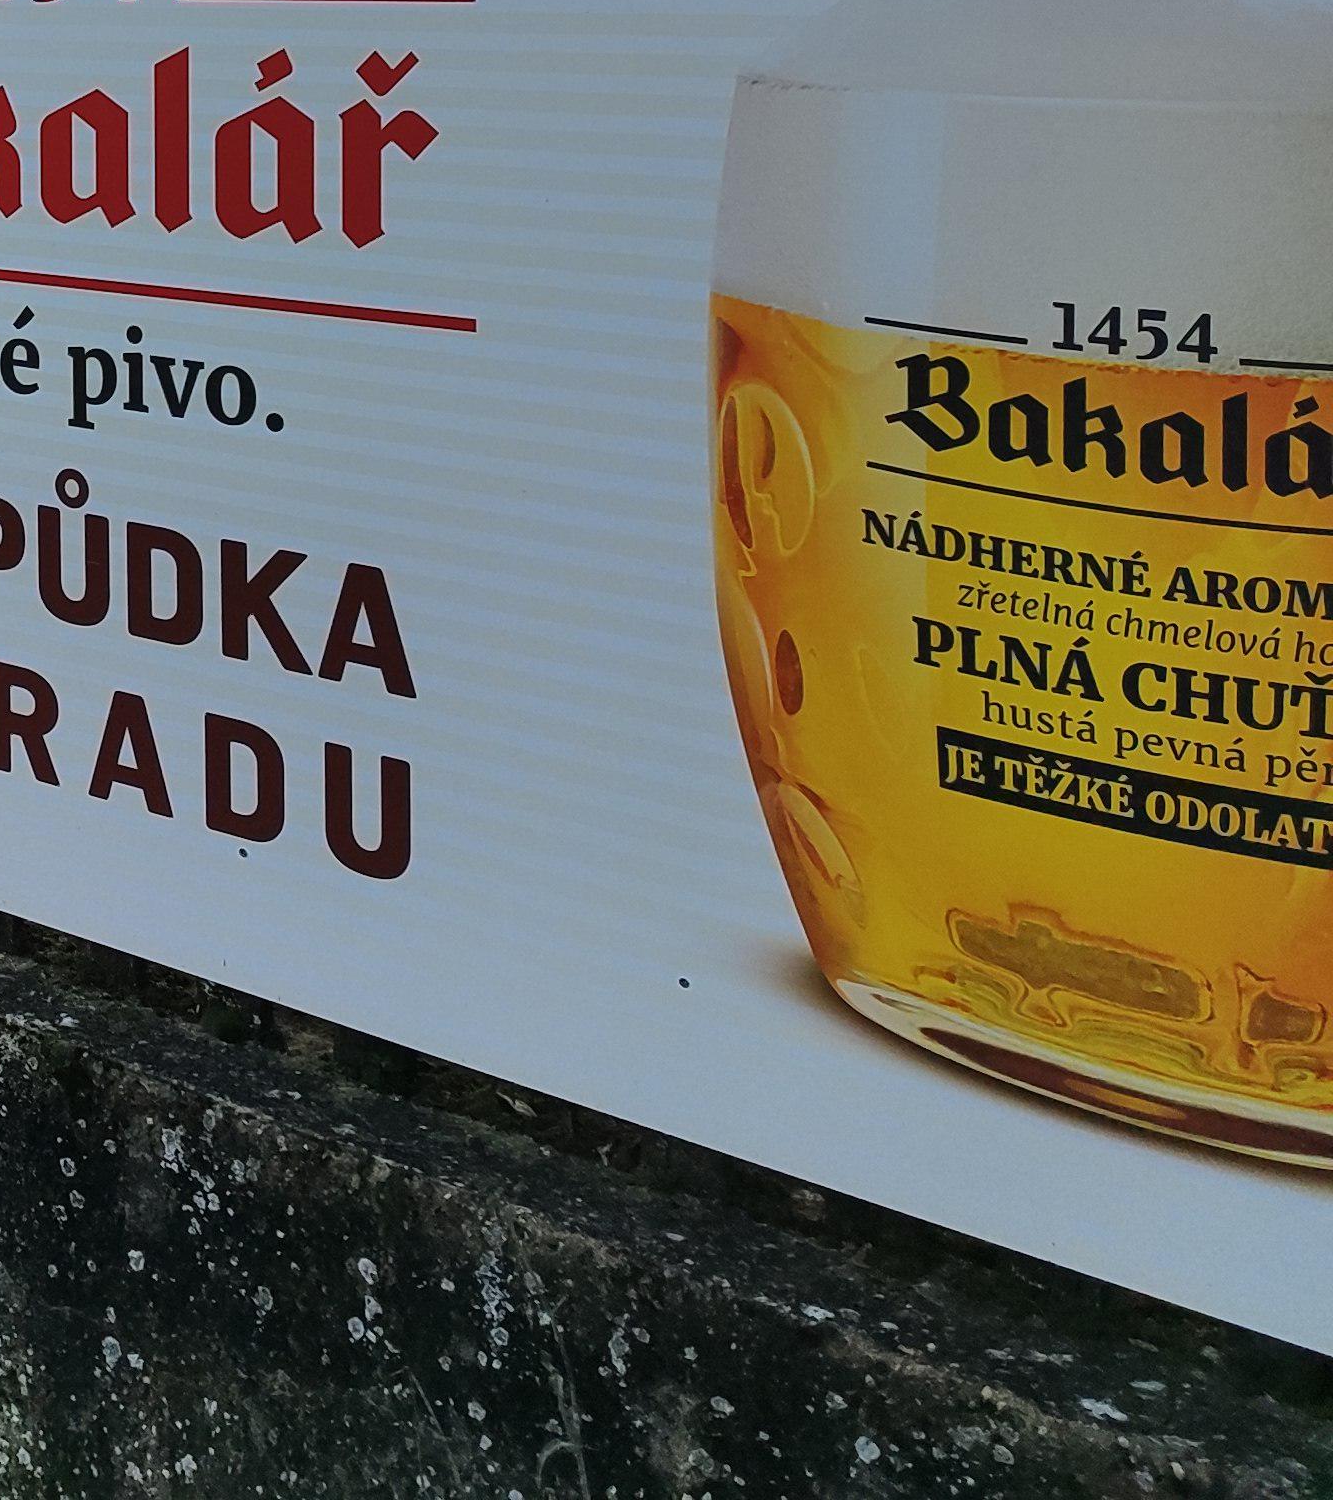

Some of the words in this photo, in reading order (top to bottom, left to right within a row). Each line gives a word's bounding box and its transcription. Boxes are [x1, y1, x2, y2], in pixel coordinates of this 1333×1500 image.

[1051, 301, 1219, 364] 1454
[67, 325, 286, 431] pivo.
[884, 352, 1333, 500] Bakalá
[861, 508, 1151, 598] NÁDHERNÉ
[1161, 565, 1333, 621] AROM
[911, 615, 1105, 703] PLNÁ
[957, 581, 1095, 632] zřetelná
[1105, 607, 1282, 661] chmelová
[1294, 631, 1333, 667] ho
[981, 689, 1098, 745] hustá
[1114, 726, 1247, 773] pevná
[943, 743, 986, 785] JE
[994, 754, 1135, 819] TĚŽKÉ
